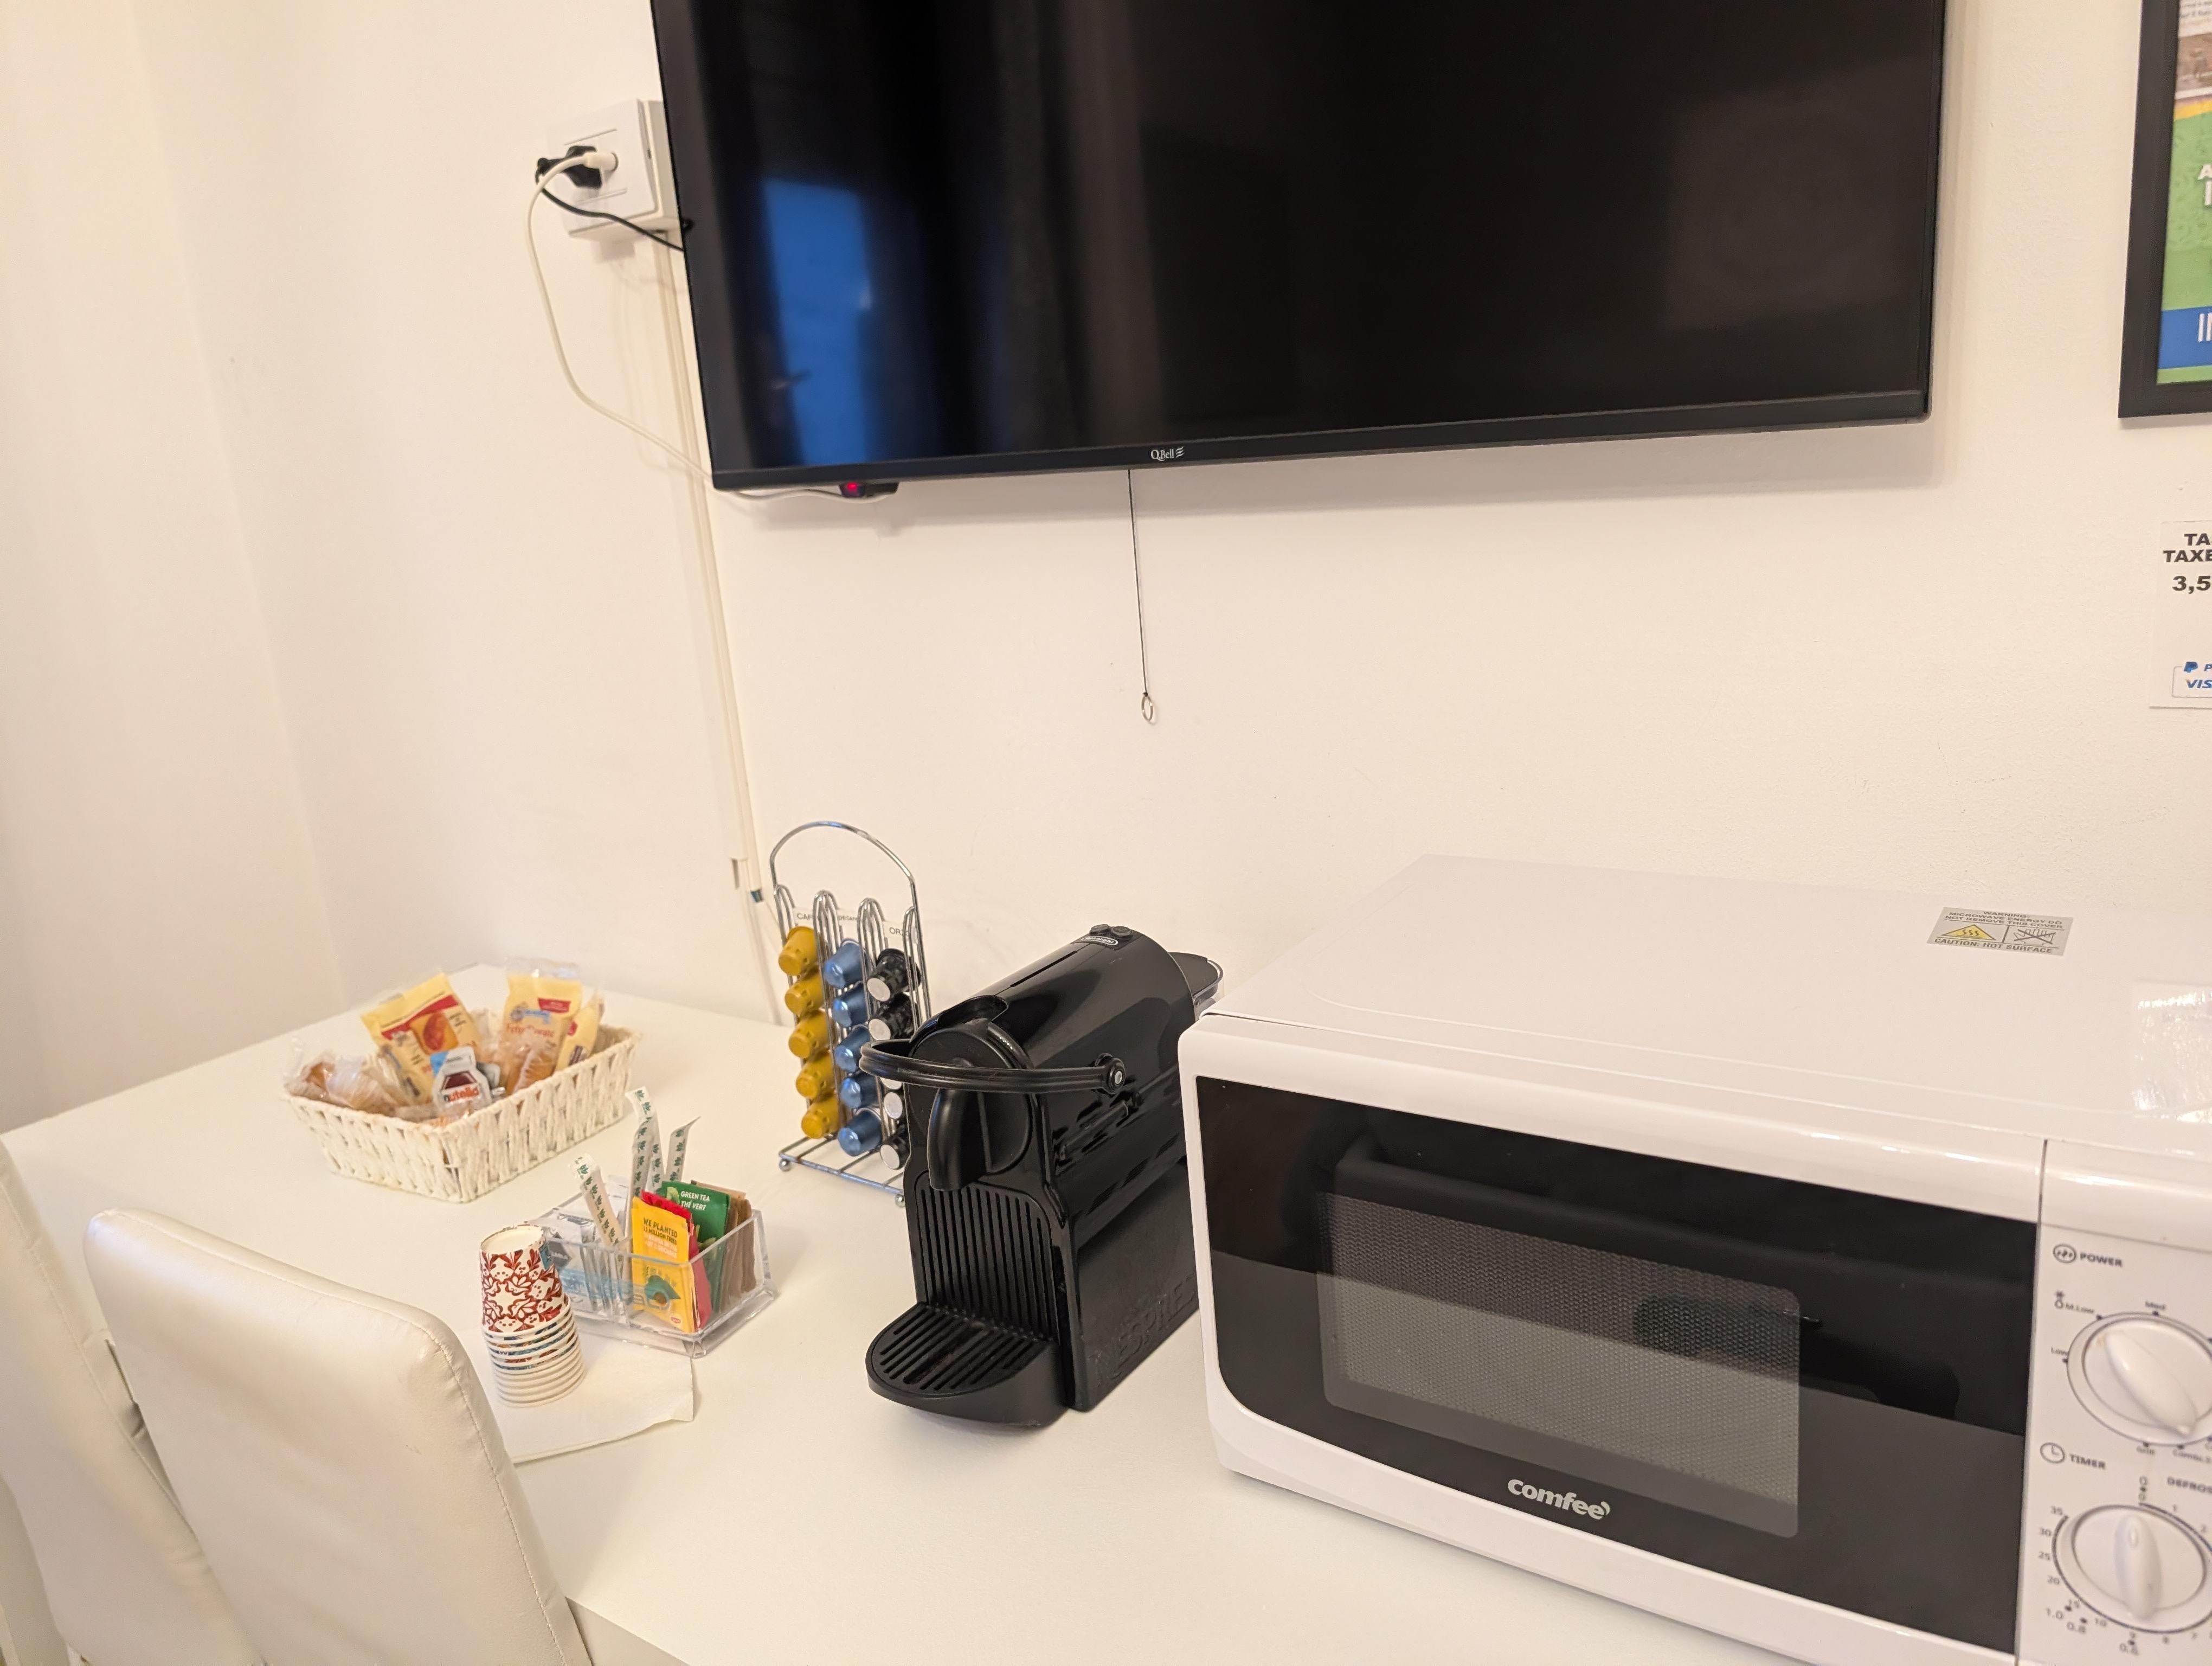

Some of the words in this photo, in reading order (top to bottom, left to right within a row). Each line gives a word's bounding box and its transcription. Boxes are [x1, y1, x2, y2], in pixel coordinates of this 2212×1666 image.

[2184, 533, 2211, 546] TA
[2185, 679, 2212, 689] VIS
[1949, 912, 2004, 920] MICROWAVE
[1934, 938, 1980, 947] CAUTION:
[2005, 944, 2053, 953] SURFACE
[680, 1190, 699, 1201] GREEN
[700, 1194, 710, 1202] TEA
[680, 1199, 692, 1209] THÉ
[692, 1202, 707, 1211] VERT
[644, 1218, 652, 1227] WE
[653, 1221, 678, 1238] PLANTED
[2080, 1252, 2123, 1267] POWER
[2069, 1453, 2106, 1470] TIMER
